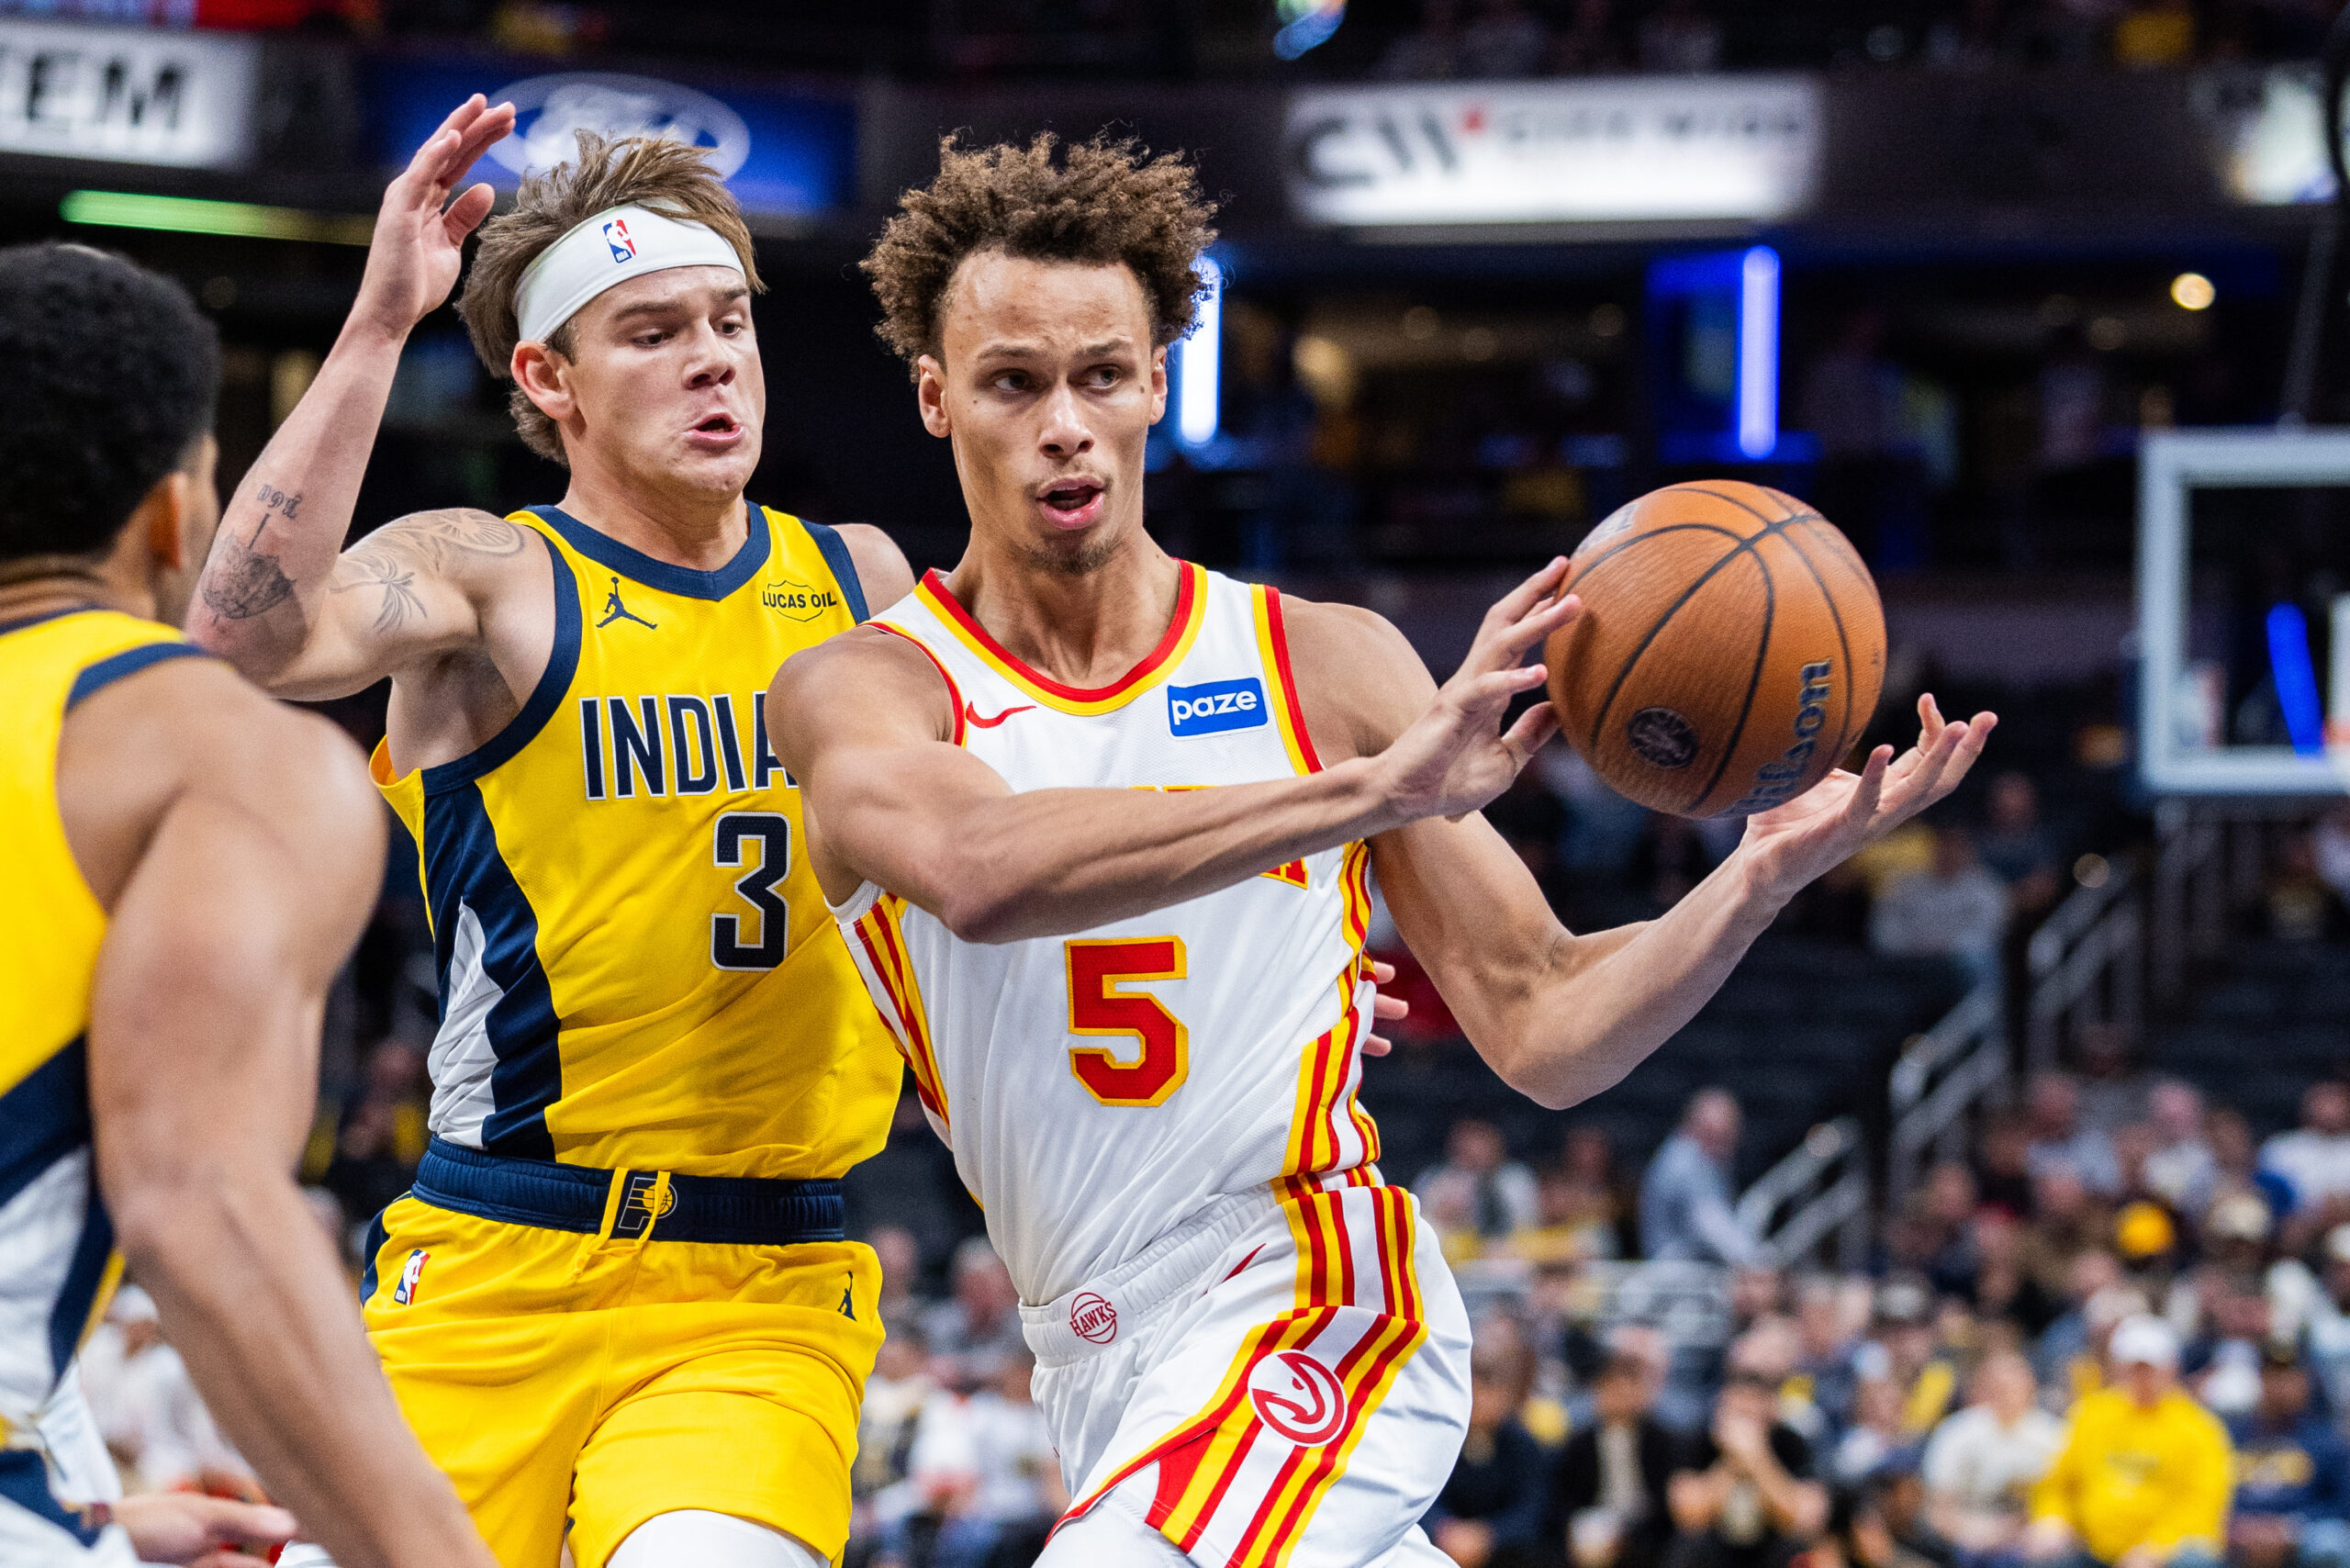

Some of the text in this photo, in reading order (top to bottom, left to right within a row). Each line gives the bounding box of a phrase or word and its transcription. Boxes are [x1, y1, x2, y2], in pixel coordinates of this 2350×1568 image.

[0, 48, 188, 130] EM
[762, 590, 837, 609] LUCAS OIL
[1171, 690, 1258, 725] paze
[710, 811, 791, 971] 3
[1064, 935, 1189, 1107] 5
[1069, 1301, 1117, 1337] HAWKS
